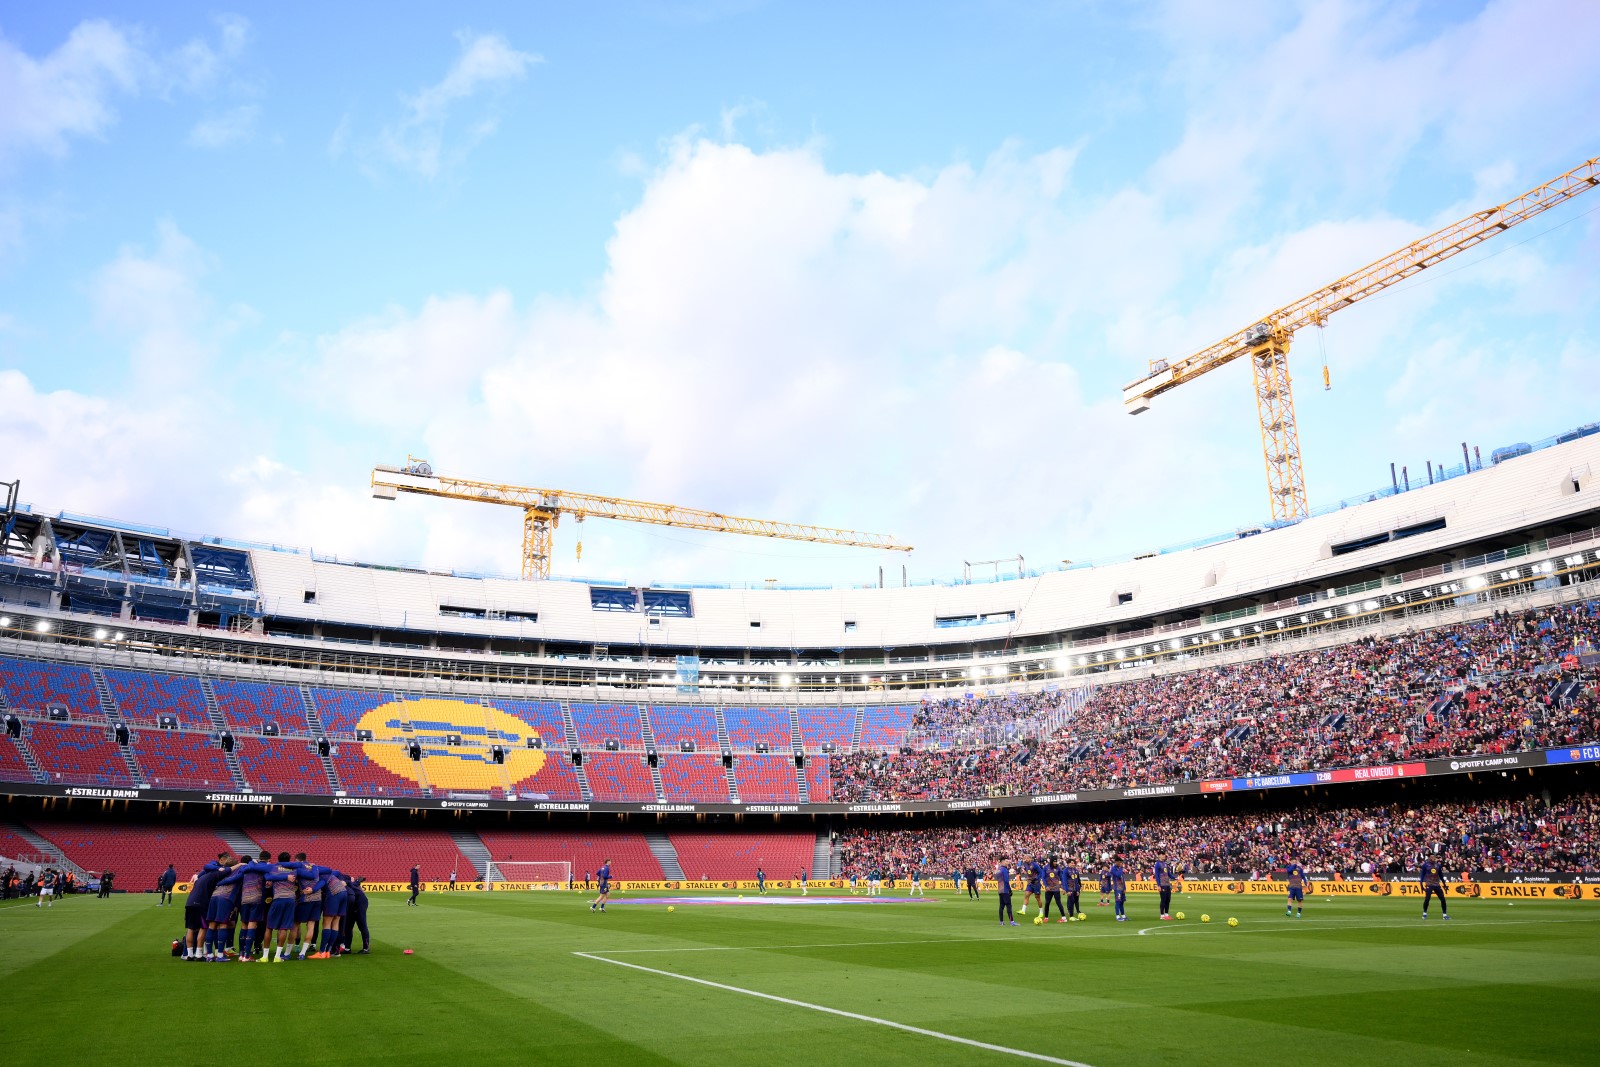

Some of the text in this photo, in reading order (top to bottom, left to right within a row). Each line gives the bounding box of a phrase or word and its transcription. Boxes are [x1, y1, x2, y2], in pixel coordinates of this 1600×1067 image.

[1583, 748, 1593, 759] FC
[1459, 757, 1518, 769] SPOTIFY CAMP NOU
[1354, 766, 1394, 779] REAL OVIEDO
[1254, 775, 1291, 787] FC BARCELONA
[72, 787, 139, 798] ESTRELLA DAMM
[1127, 786, 1175, 797] ESTRELLA DAMM
[211, 793, 247, 802] ESTRELLA
[339, 798, 371, 806] ESTRELLA
[1035, 793, 1077, 803] ESTRELLA DAMM
[951, 801, 975, 809] ESTRELLA
[1187, 883, 1223, 891] STANLEY
[1251, 883, 1289, 892] STANLEY
[1321, 884, 1364, 893] STANLEY
[1490, 886, 1546, 896] STANLEY
